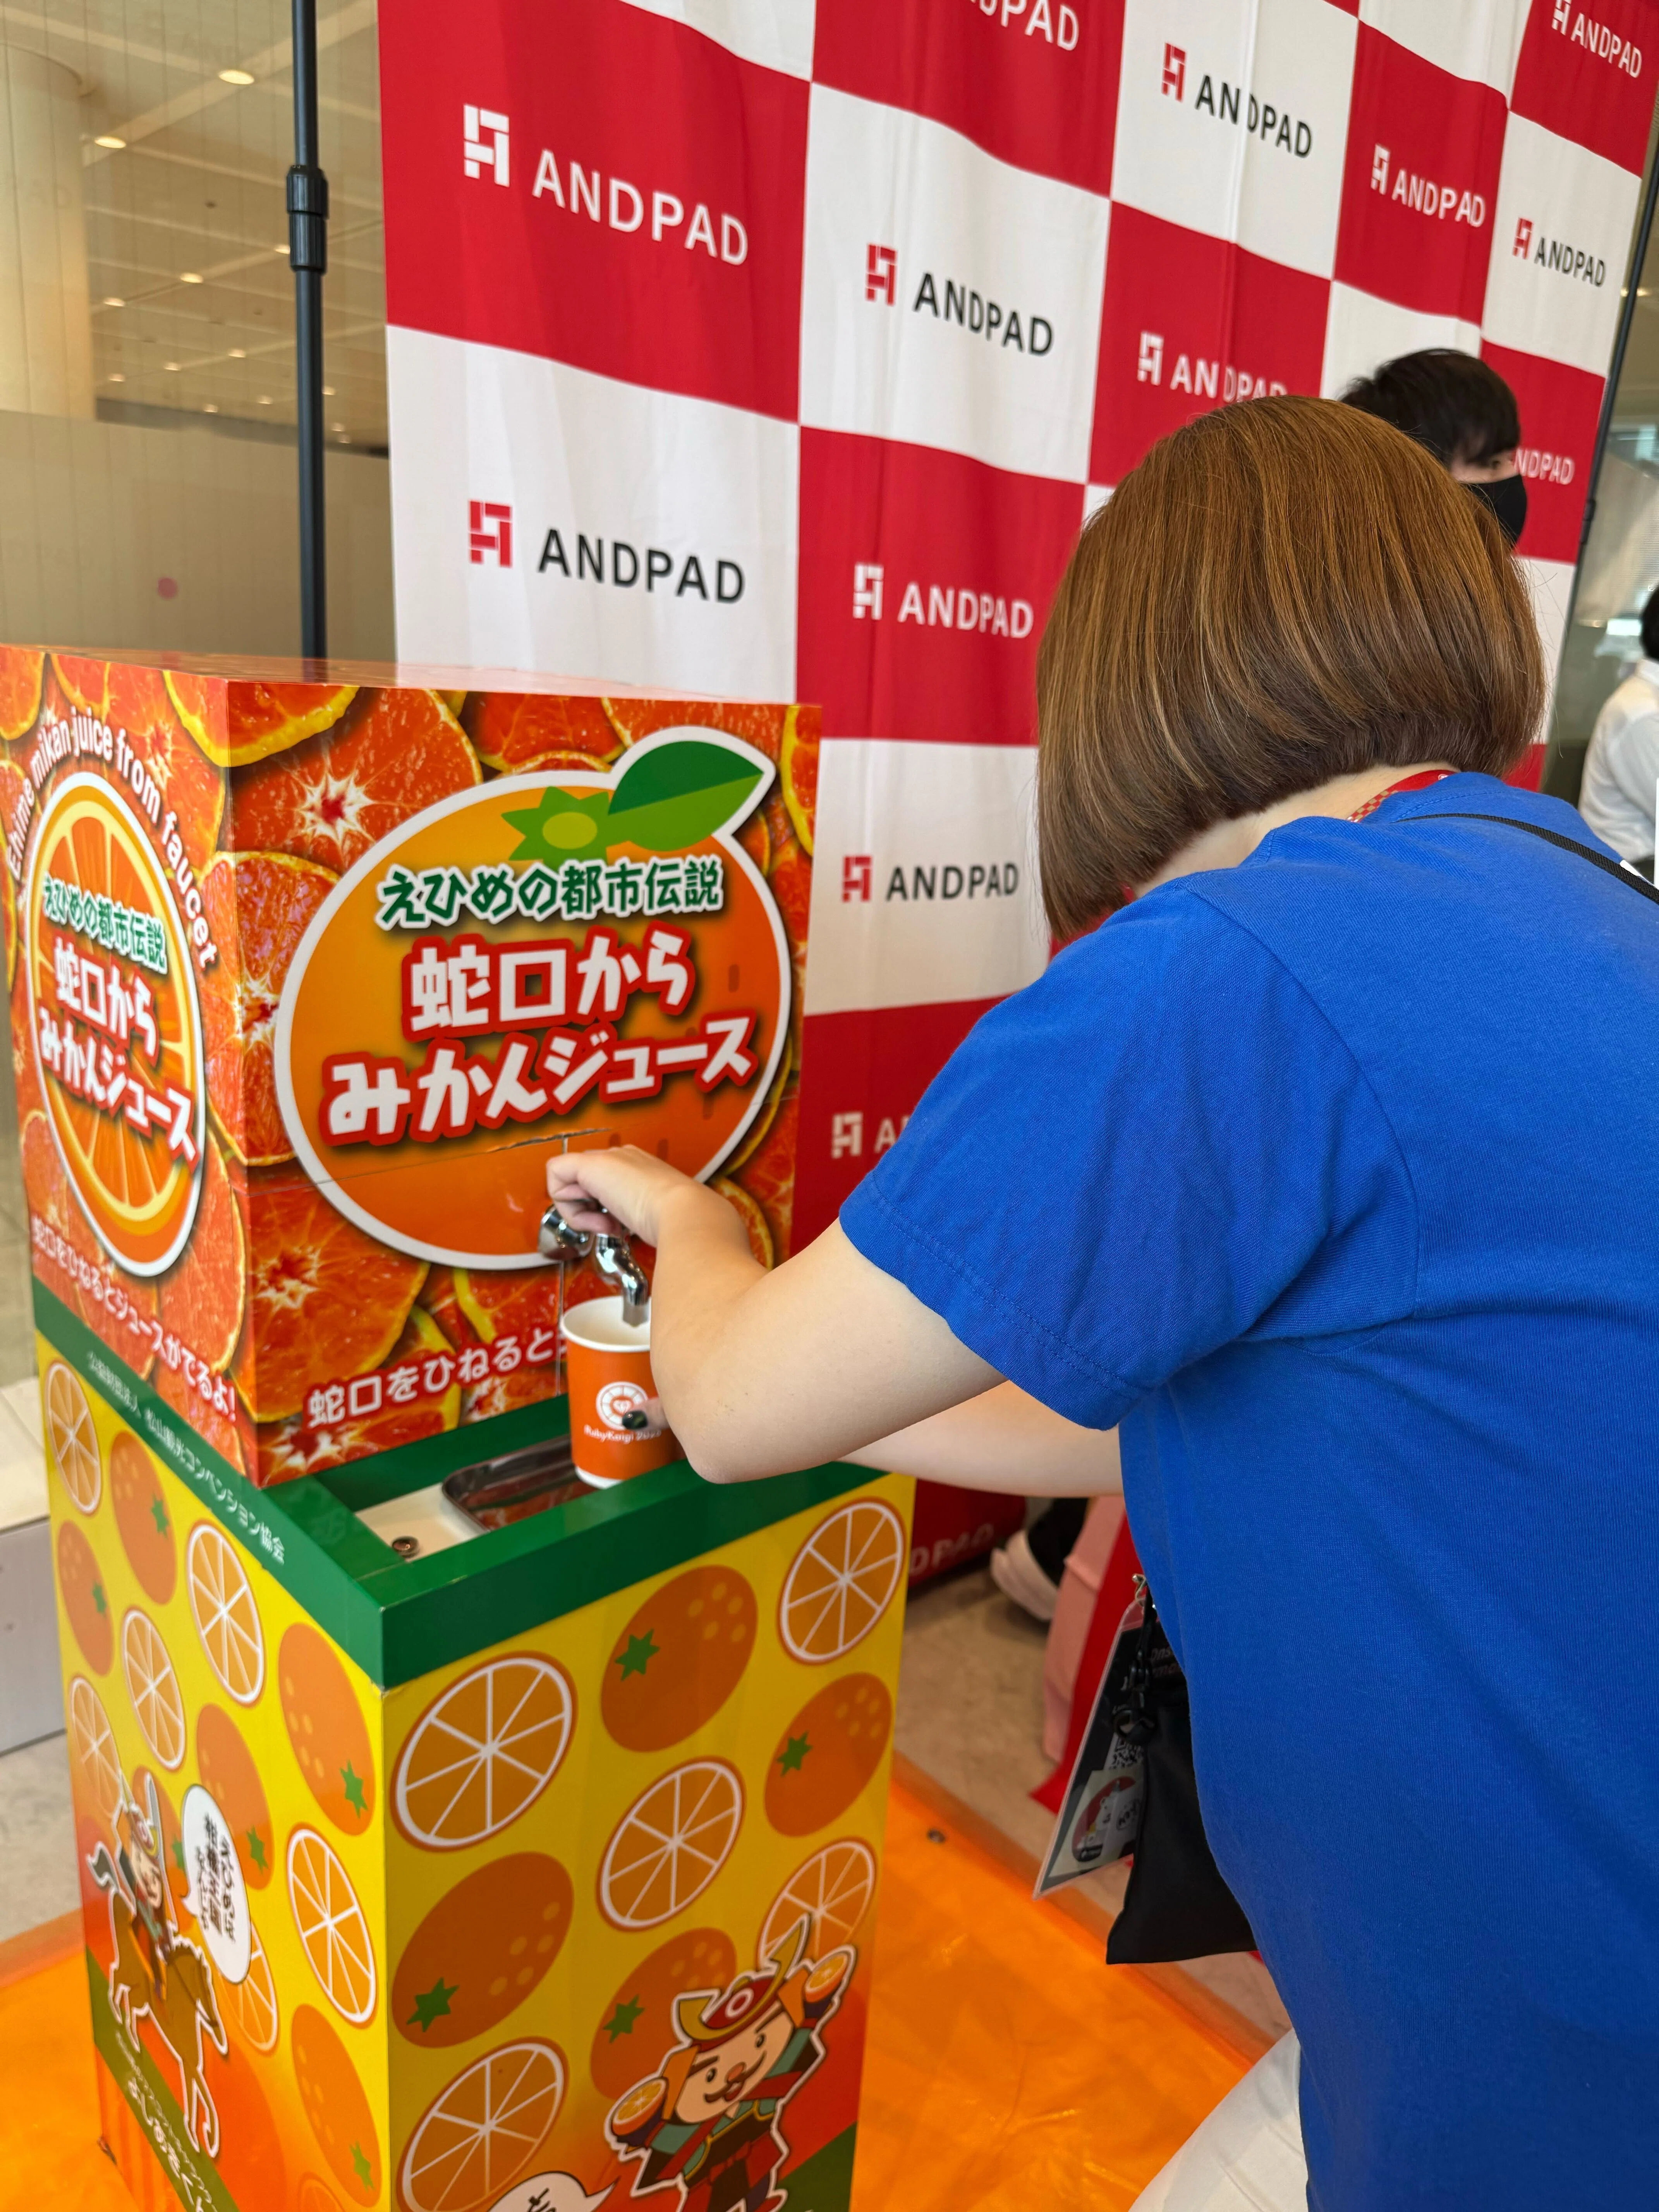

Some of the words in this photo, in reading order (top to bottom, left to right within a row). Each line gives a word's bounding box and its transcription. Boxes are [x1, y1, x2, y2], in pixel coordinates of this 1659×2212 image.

[1571, 12, 1642, 79] ANDPAD
[1196, 75, 1313, 158] ANDPAD
[532, 149, 748, 266] ANDPAD
[1392, 168, 1486, 227] ANDPAD
[1534, 236, 1606, 287] ANDPAD
[913, 272, 1053, 357] ANDPAD
[1514, 447, 1575, 485] NDPAD
[538, 528, 745, 604] ANDPAD
[898, 583, 1034, 639] ANDPAD
[7, 778, 36, 880] Ehime
[30, 718, 71, 788] mikan
[70, 706, 113, 763] juice
[117, 728, 161, 824] from
[161, 811, 217, 969] faucet
[44, 874, 167, 973] えひめの都市伝説
[379, 857, 722, 926] えひめの都市伝説
[886, 862, 1019, 902] ANDPAD
[55, 937, 156, 1056] 蛇口から
[411, 930, 689, 1032] 蛇口から
[40, 1007, 196, 1161] みかんジュース
[329, 1016, 753, 1135] みかんジュース
